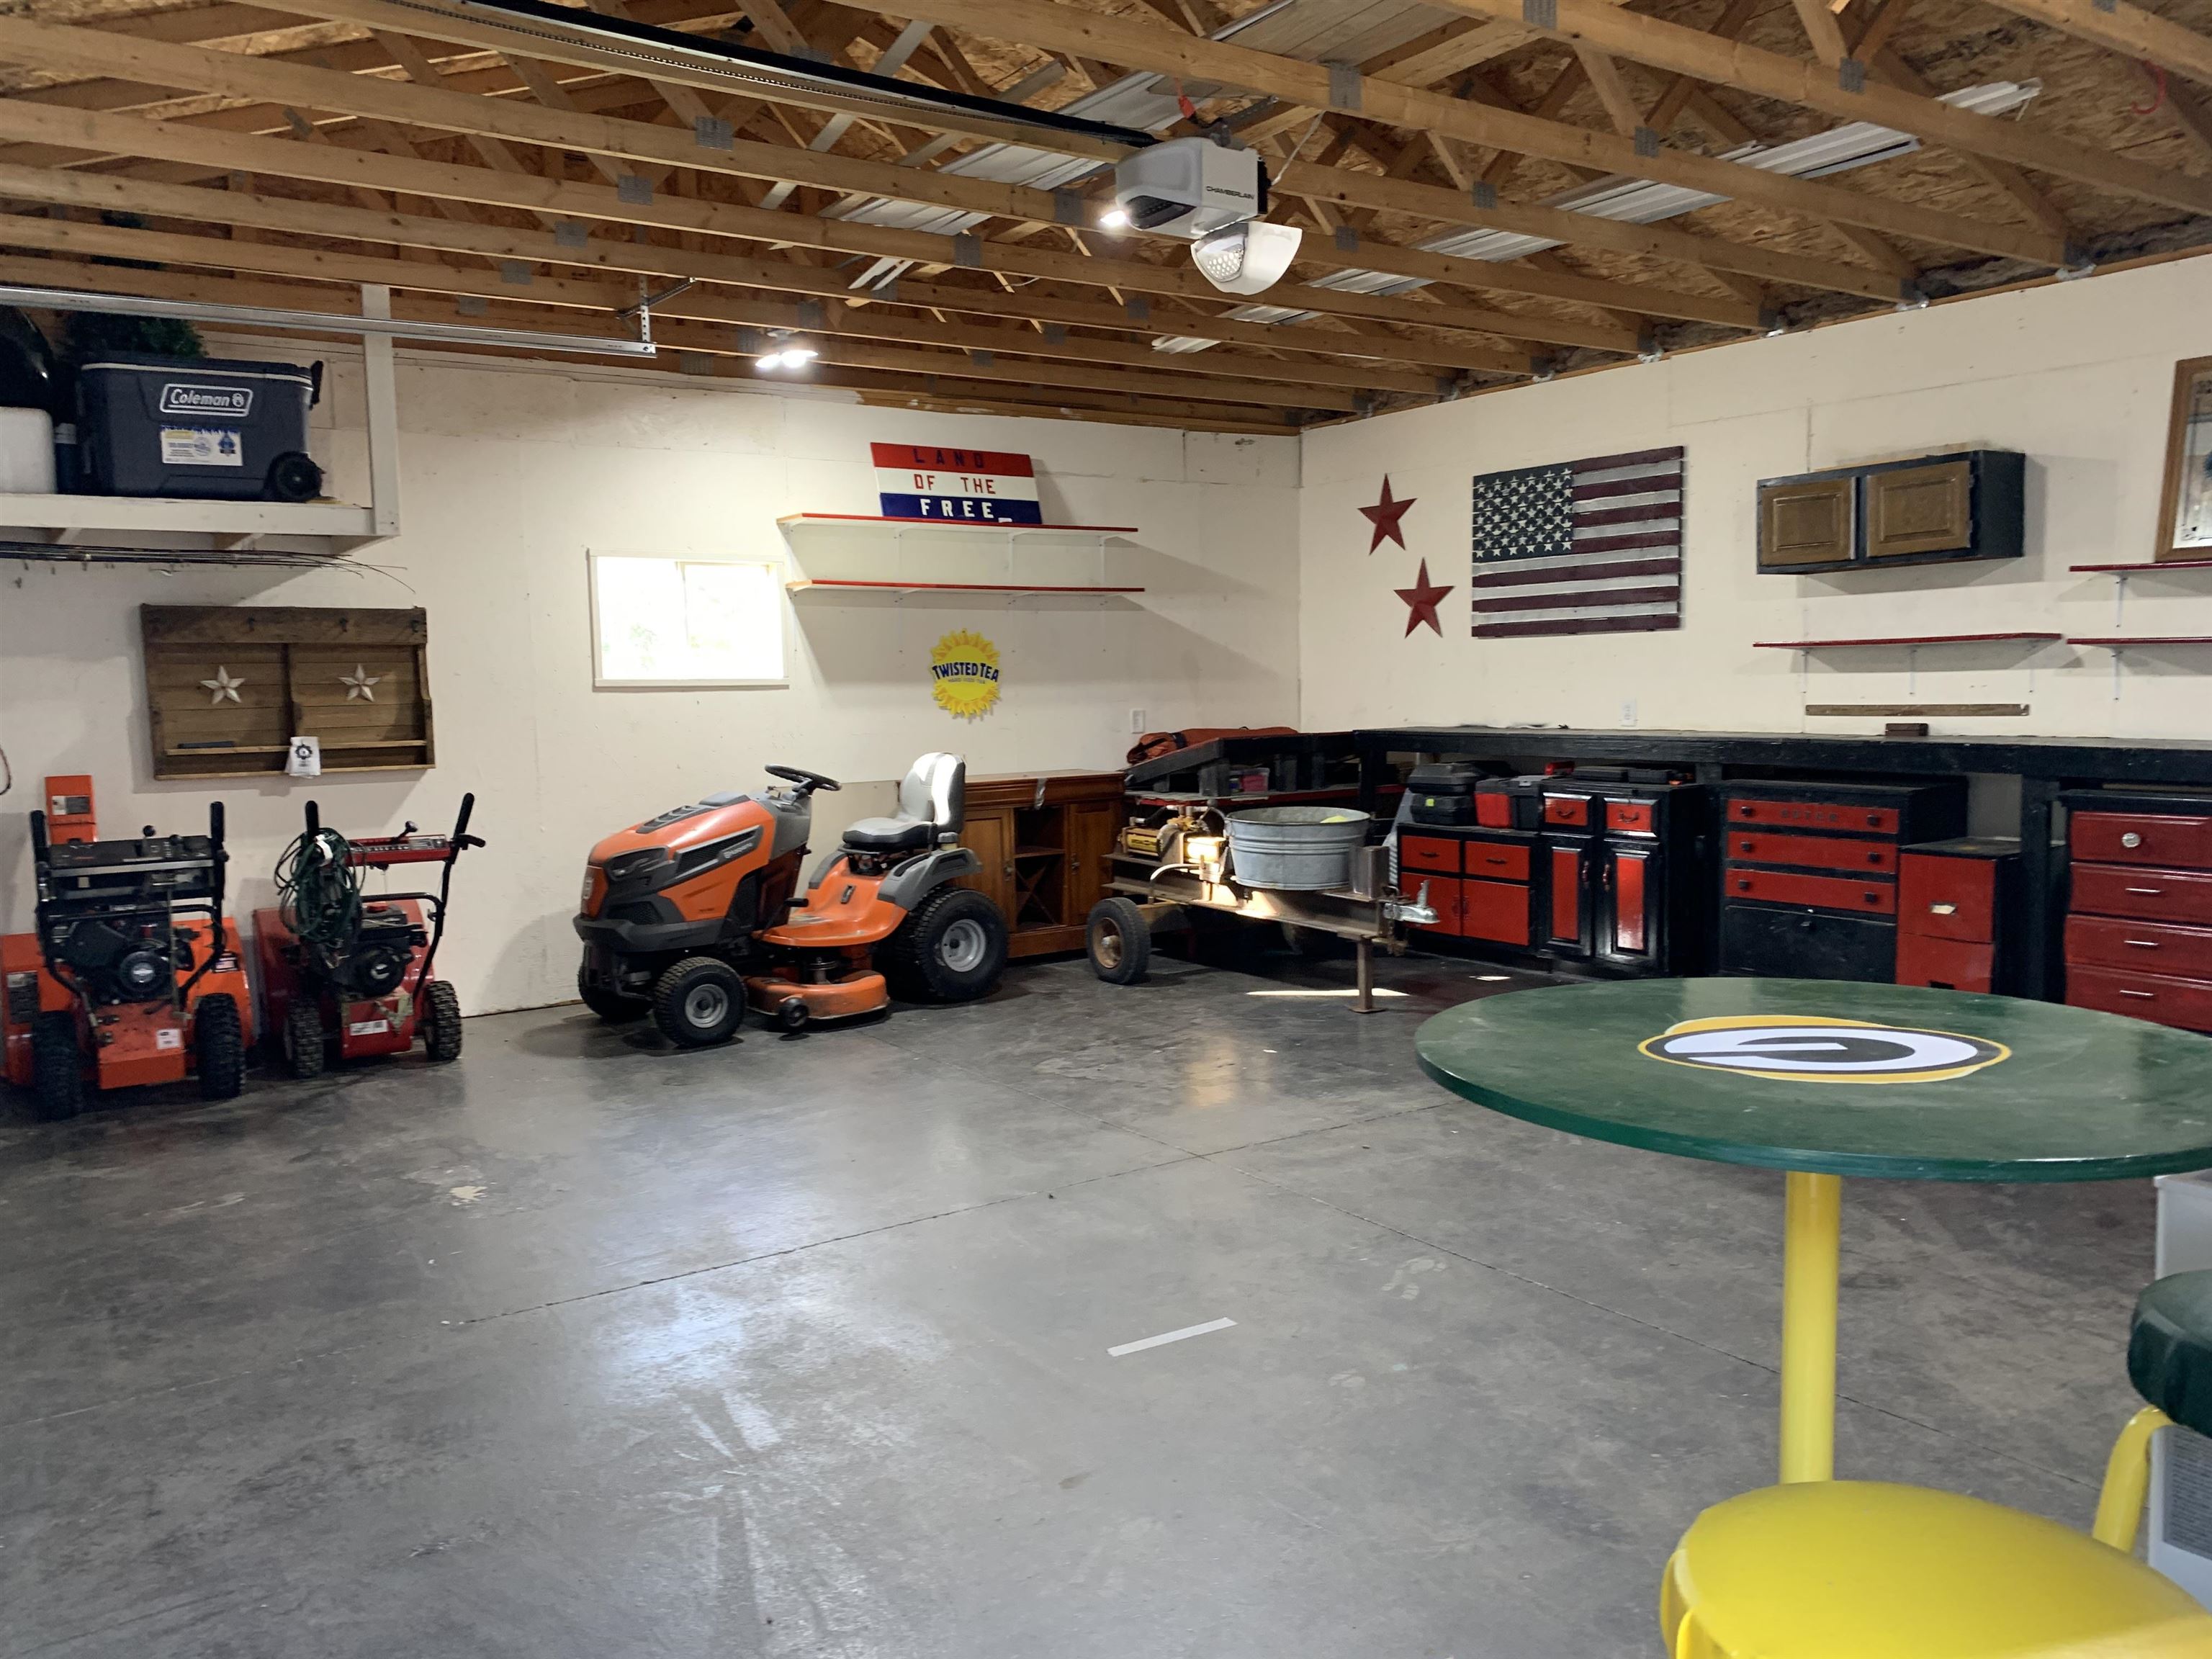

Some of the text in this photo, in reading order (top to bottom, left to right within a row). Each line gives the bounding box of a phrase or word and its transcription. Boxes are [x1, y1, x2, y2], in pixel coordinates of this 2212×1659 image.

[1206, 186, 1254, 199] CHAMBERLAIN
[171, 389, 230, 406] Coleman
[913, 449, 984, 467] LAND
[914, 474, 996, 494] OF THE
[920, 498, 994, 518] FREE
[932, 662, 999, 683] TWISTED TEA
